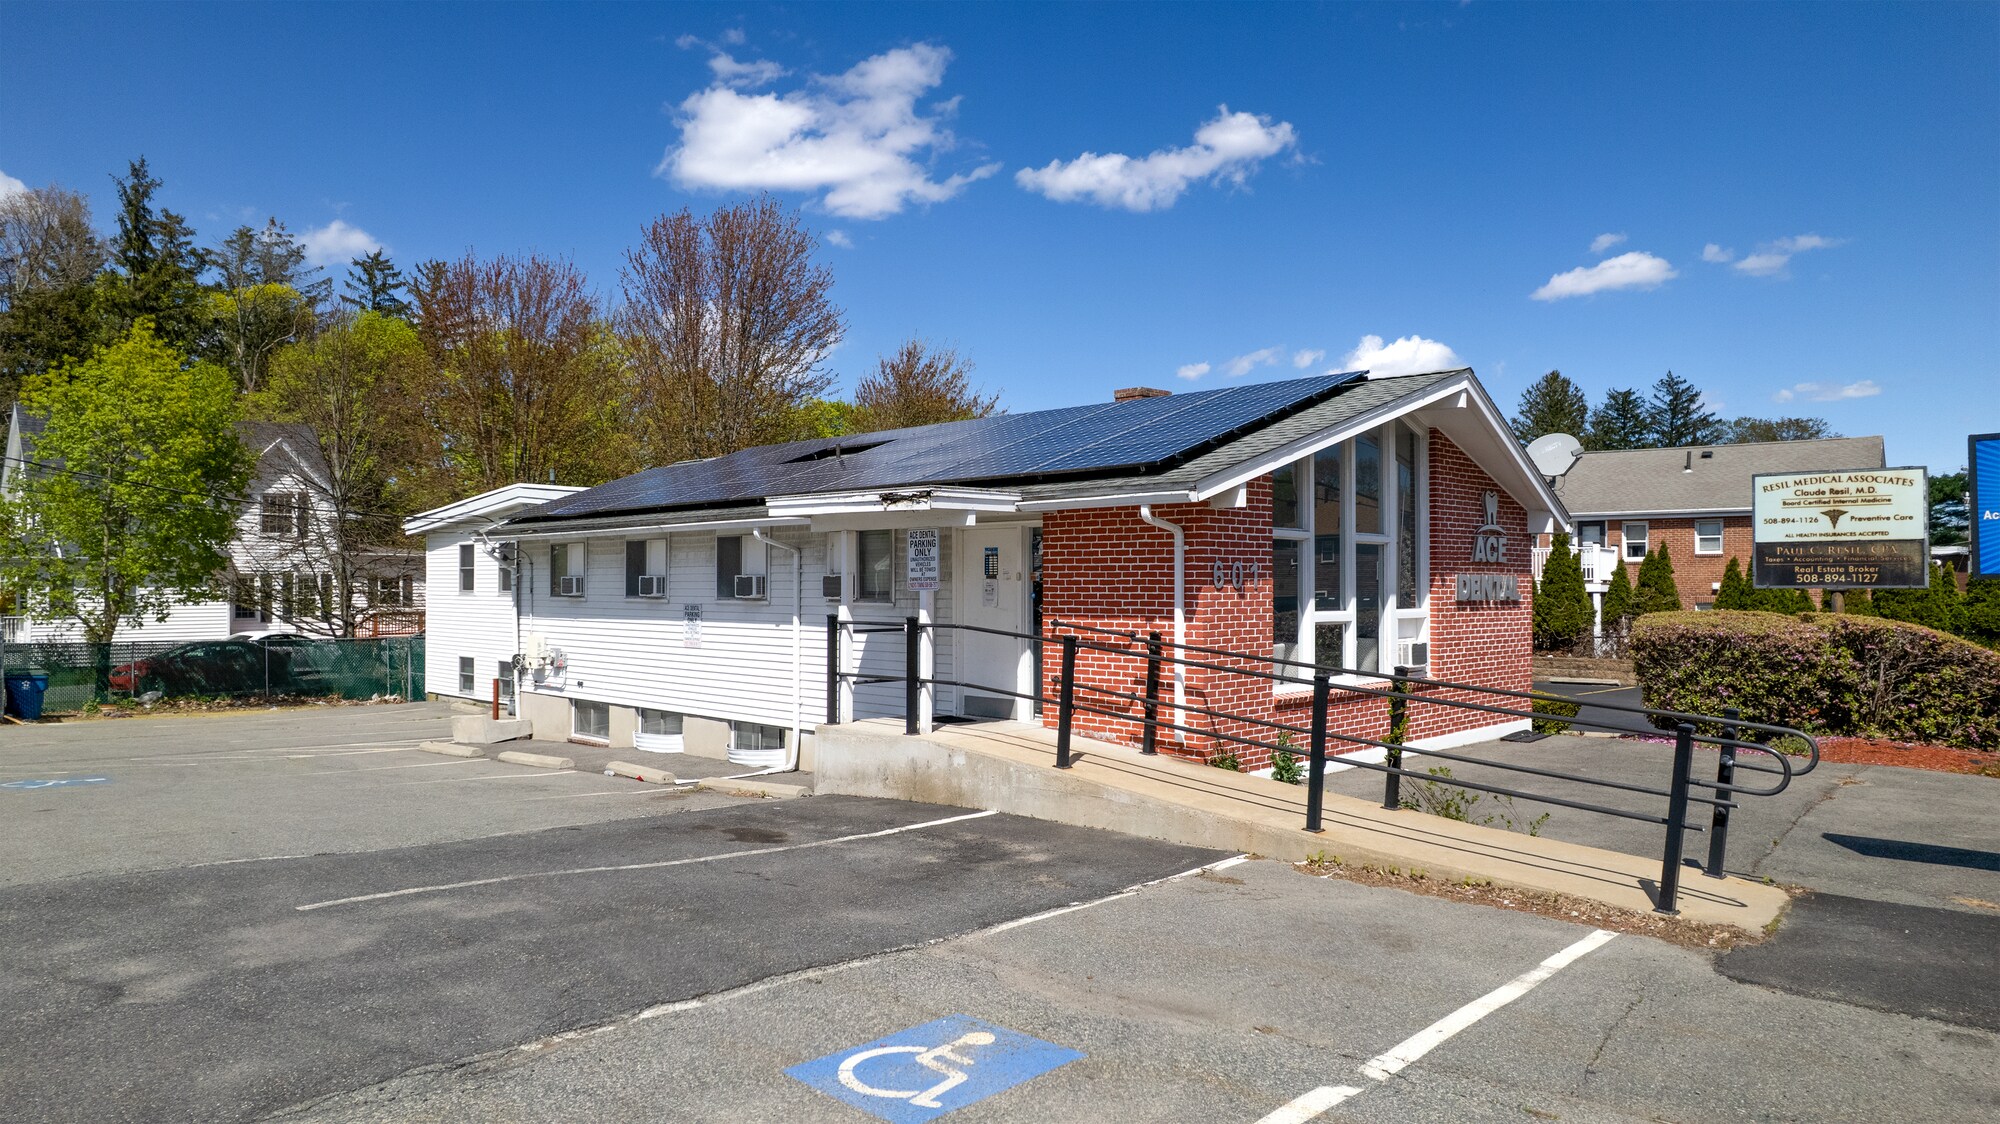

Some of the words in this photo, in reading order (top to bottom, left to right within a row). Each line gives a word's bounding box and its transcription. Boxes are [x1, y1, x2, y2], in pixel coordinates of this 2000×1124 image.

[1762, 480, 1791, 493] RESIL
[1793, 475, 1844, 487] MEDICAL
[1846, 475, 1915, 487] ASSOCIATES
[1794, 488, 1826, 497] Claude
[1829, 487, 1853, 496] Resil,
[1855, 486, 1877, 494] M.D.
[1983, 510, 2000, 520] Ac
[1763, 516, 1819, 525] 508-894-1126
[909, 531, 919, 539] ACE
[919, 530, 936, 539] DENTAL
[909, 539, 936, 549] PARKING
[914, 548, 932, 557] ONLY
[1472, 536, 1508, 563] ACE
[1871, 545, 1898, 554] CPA
[1848, 565, 1880, 573] Broker
[1212, 560, 1259, 591] 601
[1796, 573, 1878, 583] 508-894-1127
[1455, 574, 1521, 601] DENTAL
